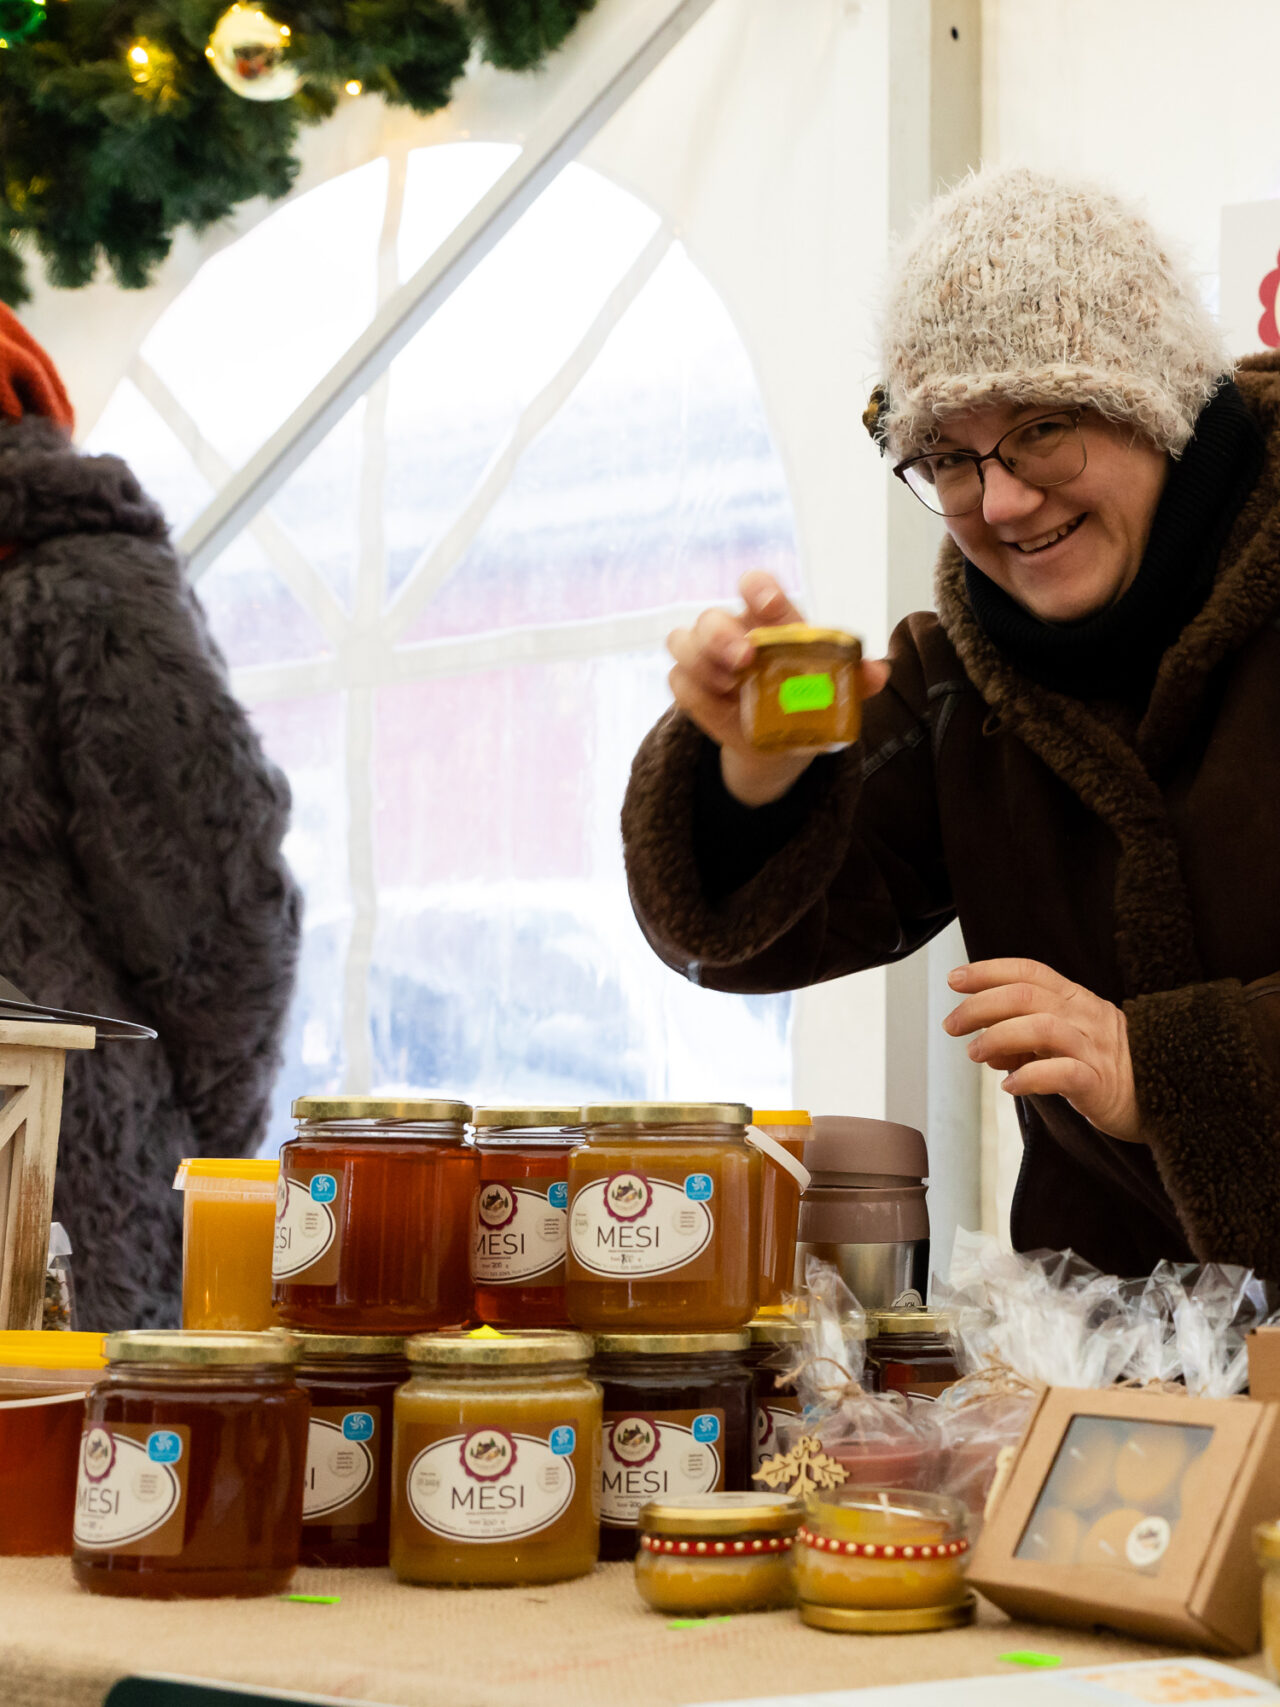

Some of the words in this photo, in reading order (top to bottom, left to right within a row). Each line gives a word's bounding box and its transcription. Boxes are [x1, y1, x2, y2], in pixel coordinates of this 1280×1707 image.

[596, 1225, 660, 1249] MESI
[601, 1470, 668, 1494] MESI
[77, 1486, 120, 1516] MESI
[451, 1484, 525, 1511] MESI
